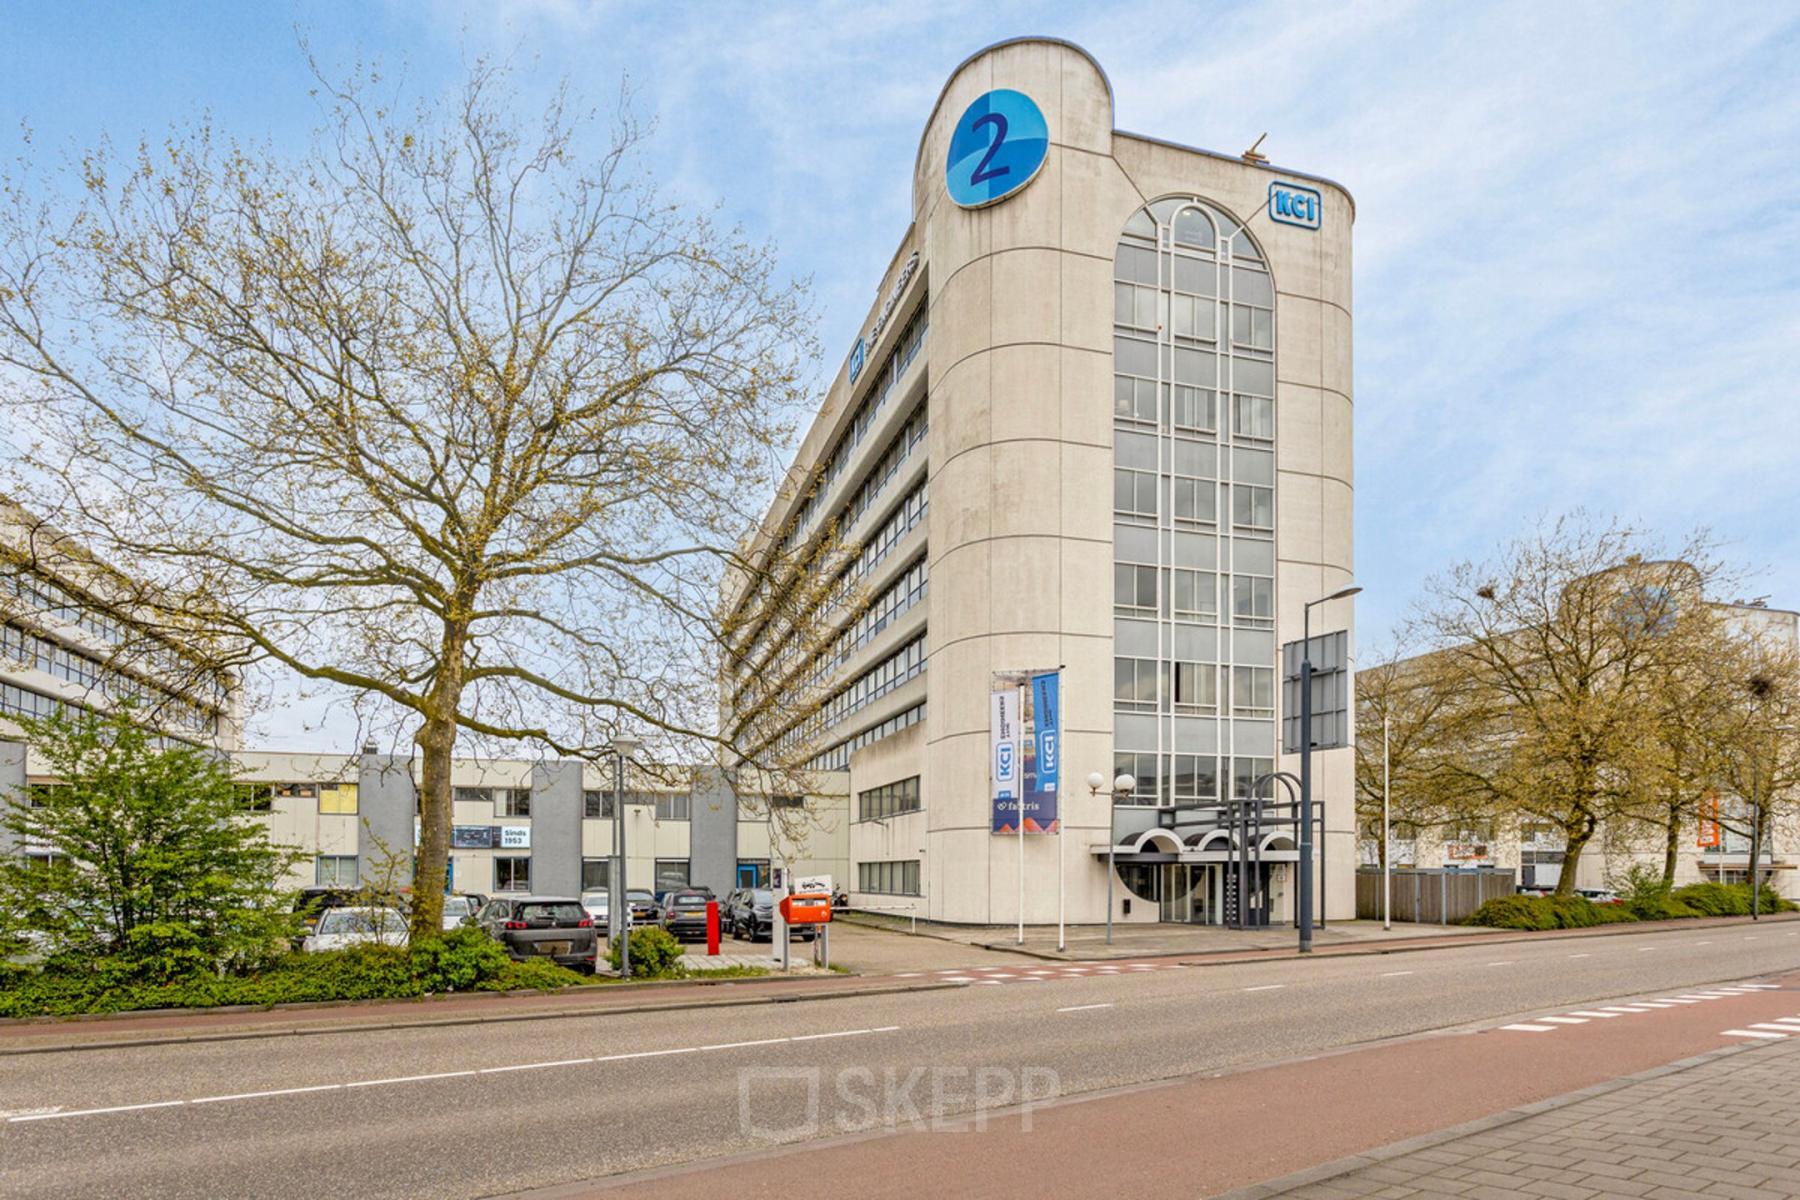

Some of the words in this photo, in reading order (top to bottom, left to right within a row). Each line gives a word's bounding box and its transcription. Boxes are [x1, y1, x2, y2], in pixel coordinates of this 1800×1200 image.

[970, 112, 1010, 186] 2
[1276, 190, 1315, 222] KCI
[1000, 747, 1011, 776] KCI
[1045, 736, 1054, 768] KCI
